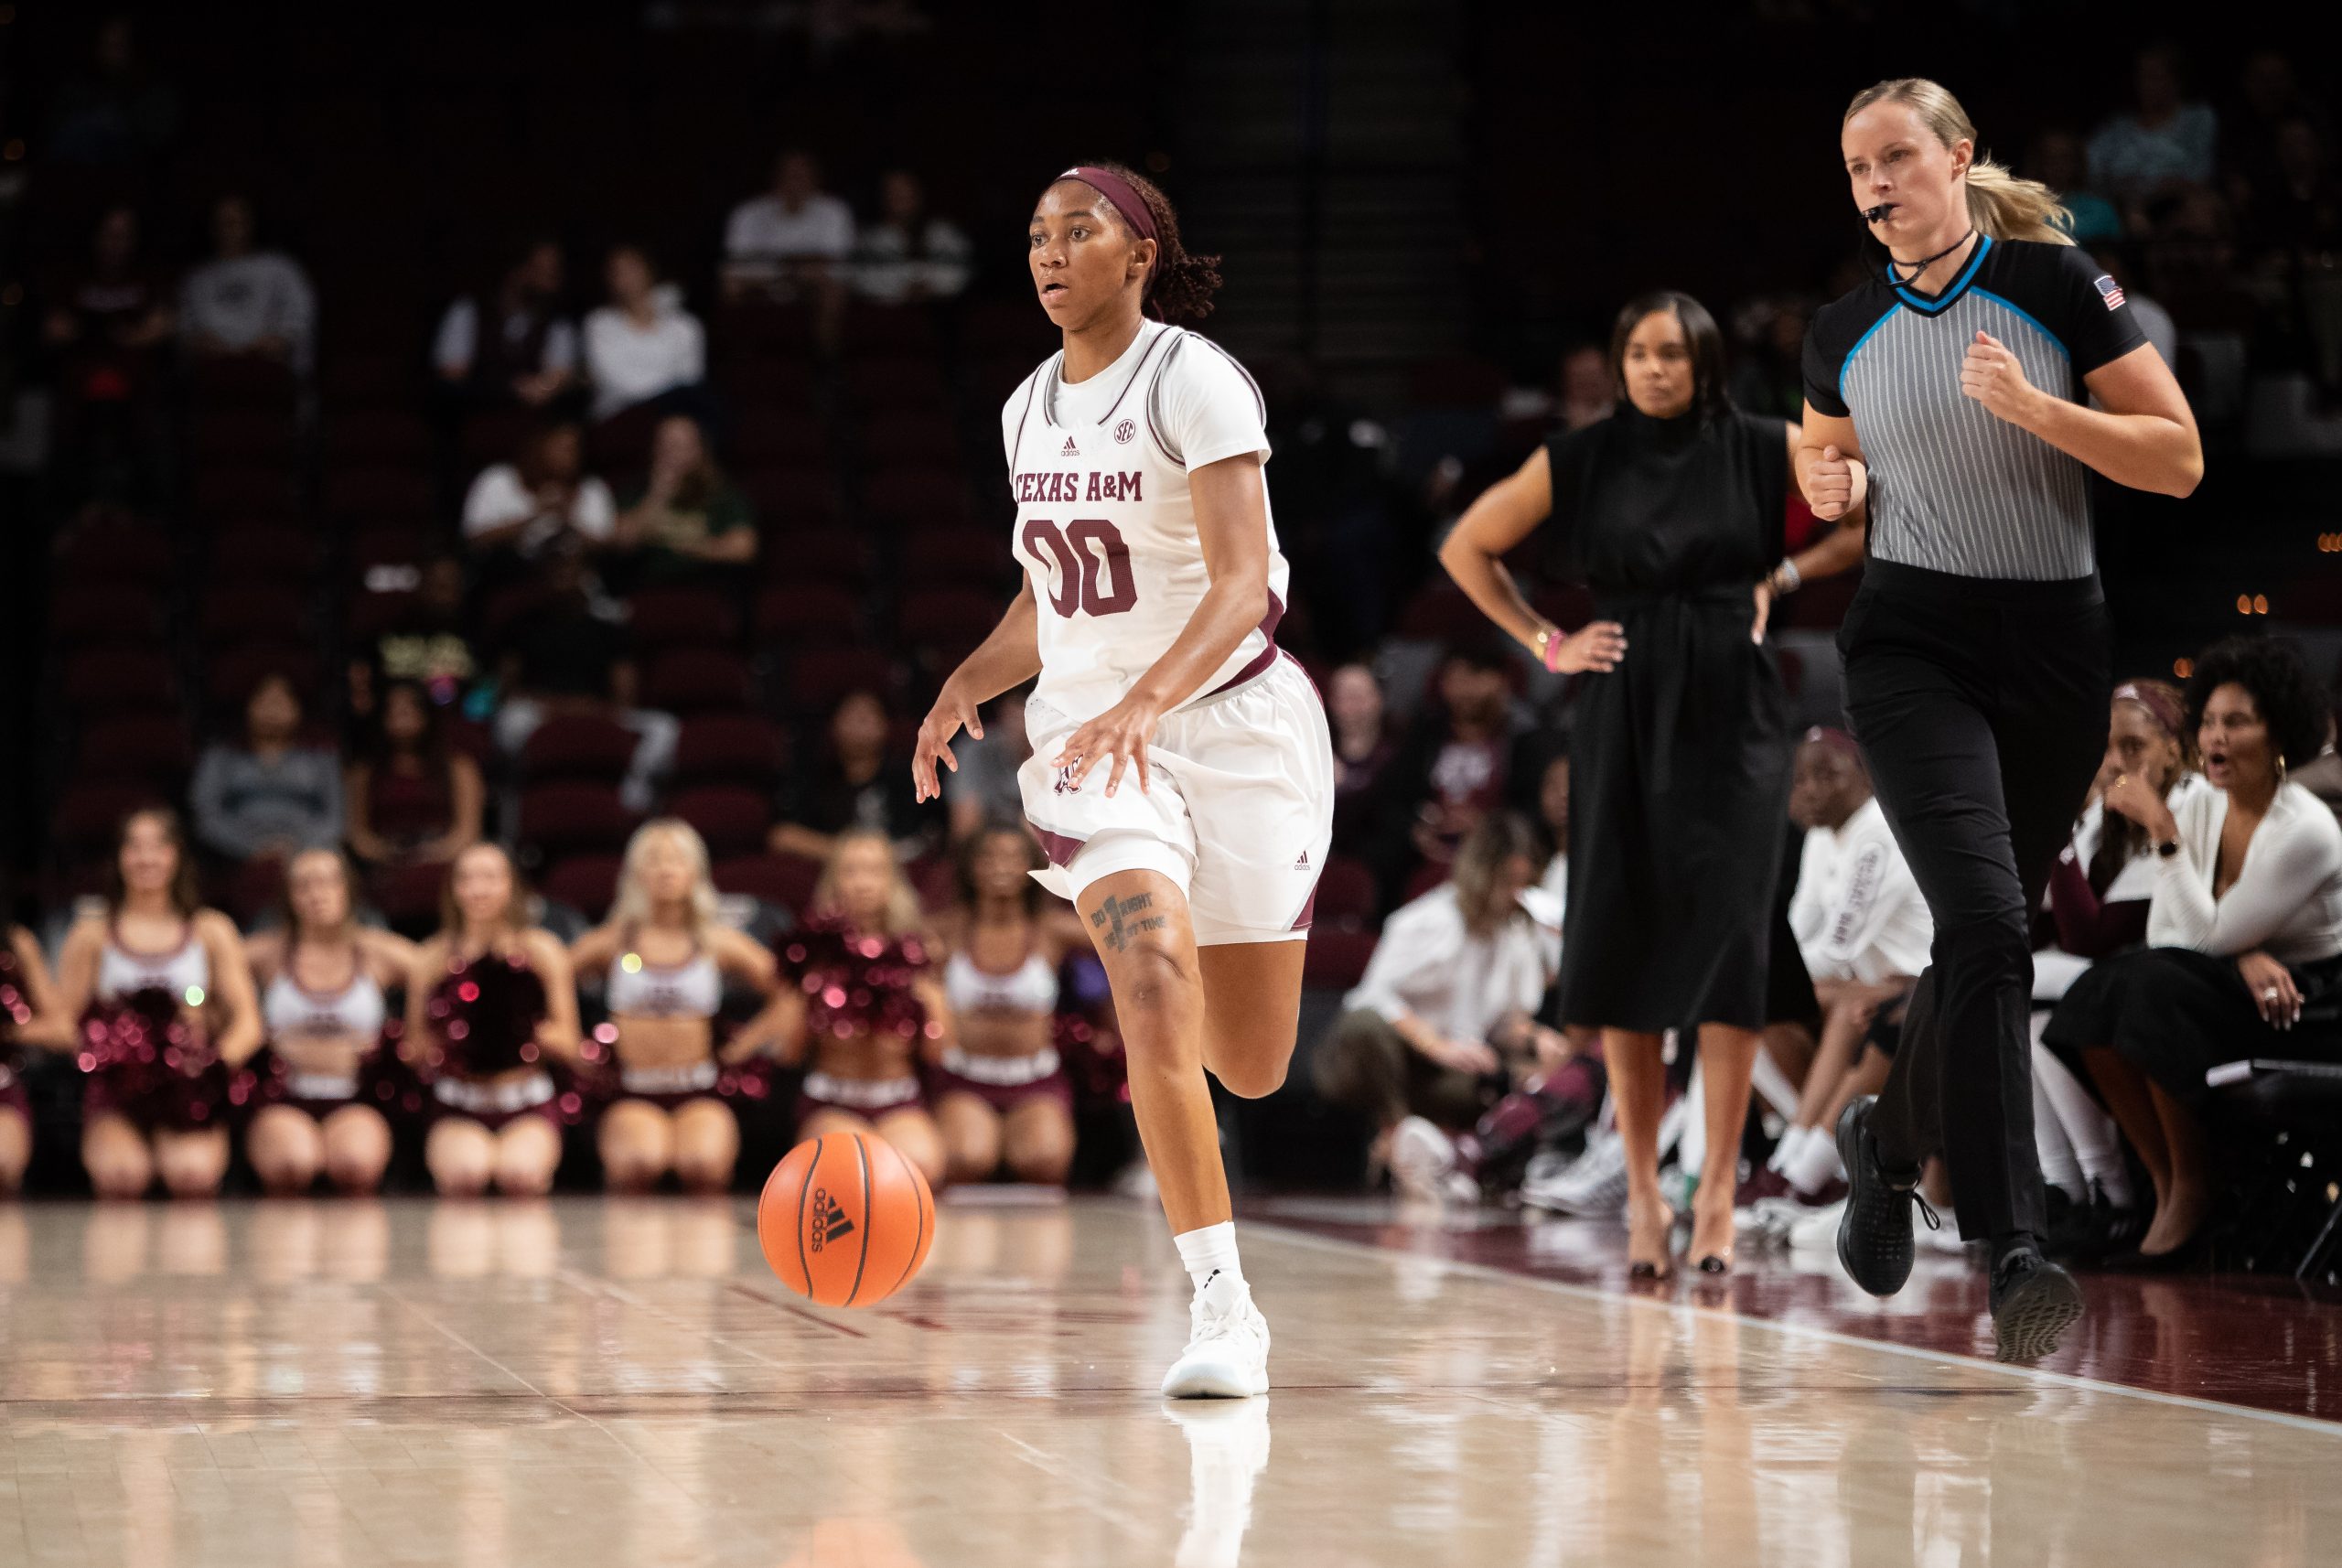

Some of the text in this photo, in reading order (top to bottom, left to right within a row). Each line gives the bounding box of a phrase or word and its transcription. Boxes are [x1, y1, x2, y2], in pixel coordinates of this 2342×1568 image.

[1116, 421, 1133, 442] SEC
[1060, 448, 1080, 457] adidas
[1015, 470, 1143, 502] TEXAS A&M
[1022, 519, 1138, 618] 00
[811, 1187, 831, 1253] adidas
